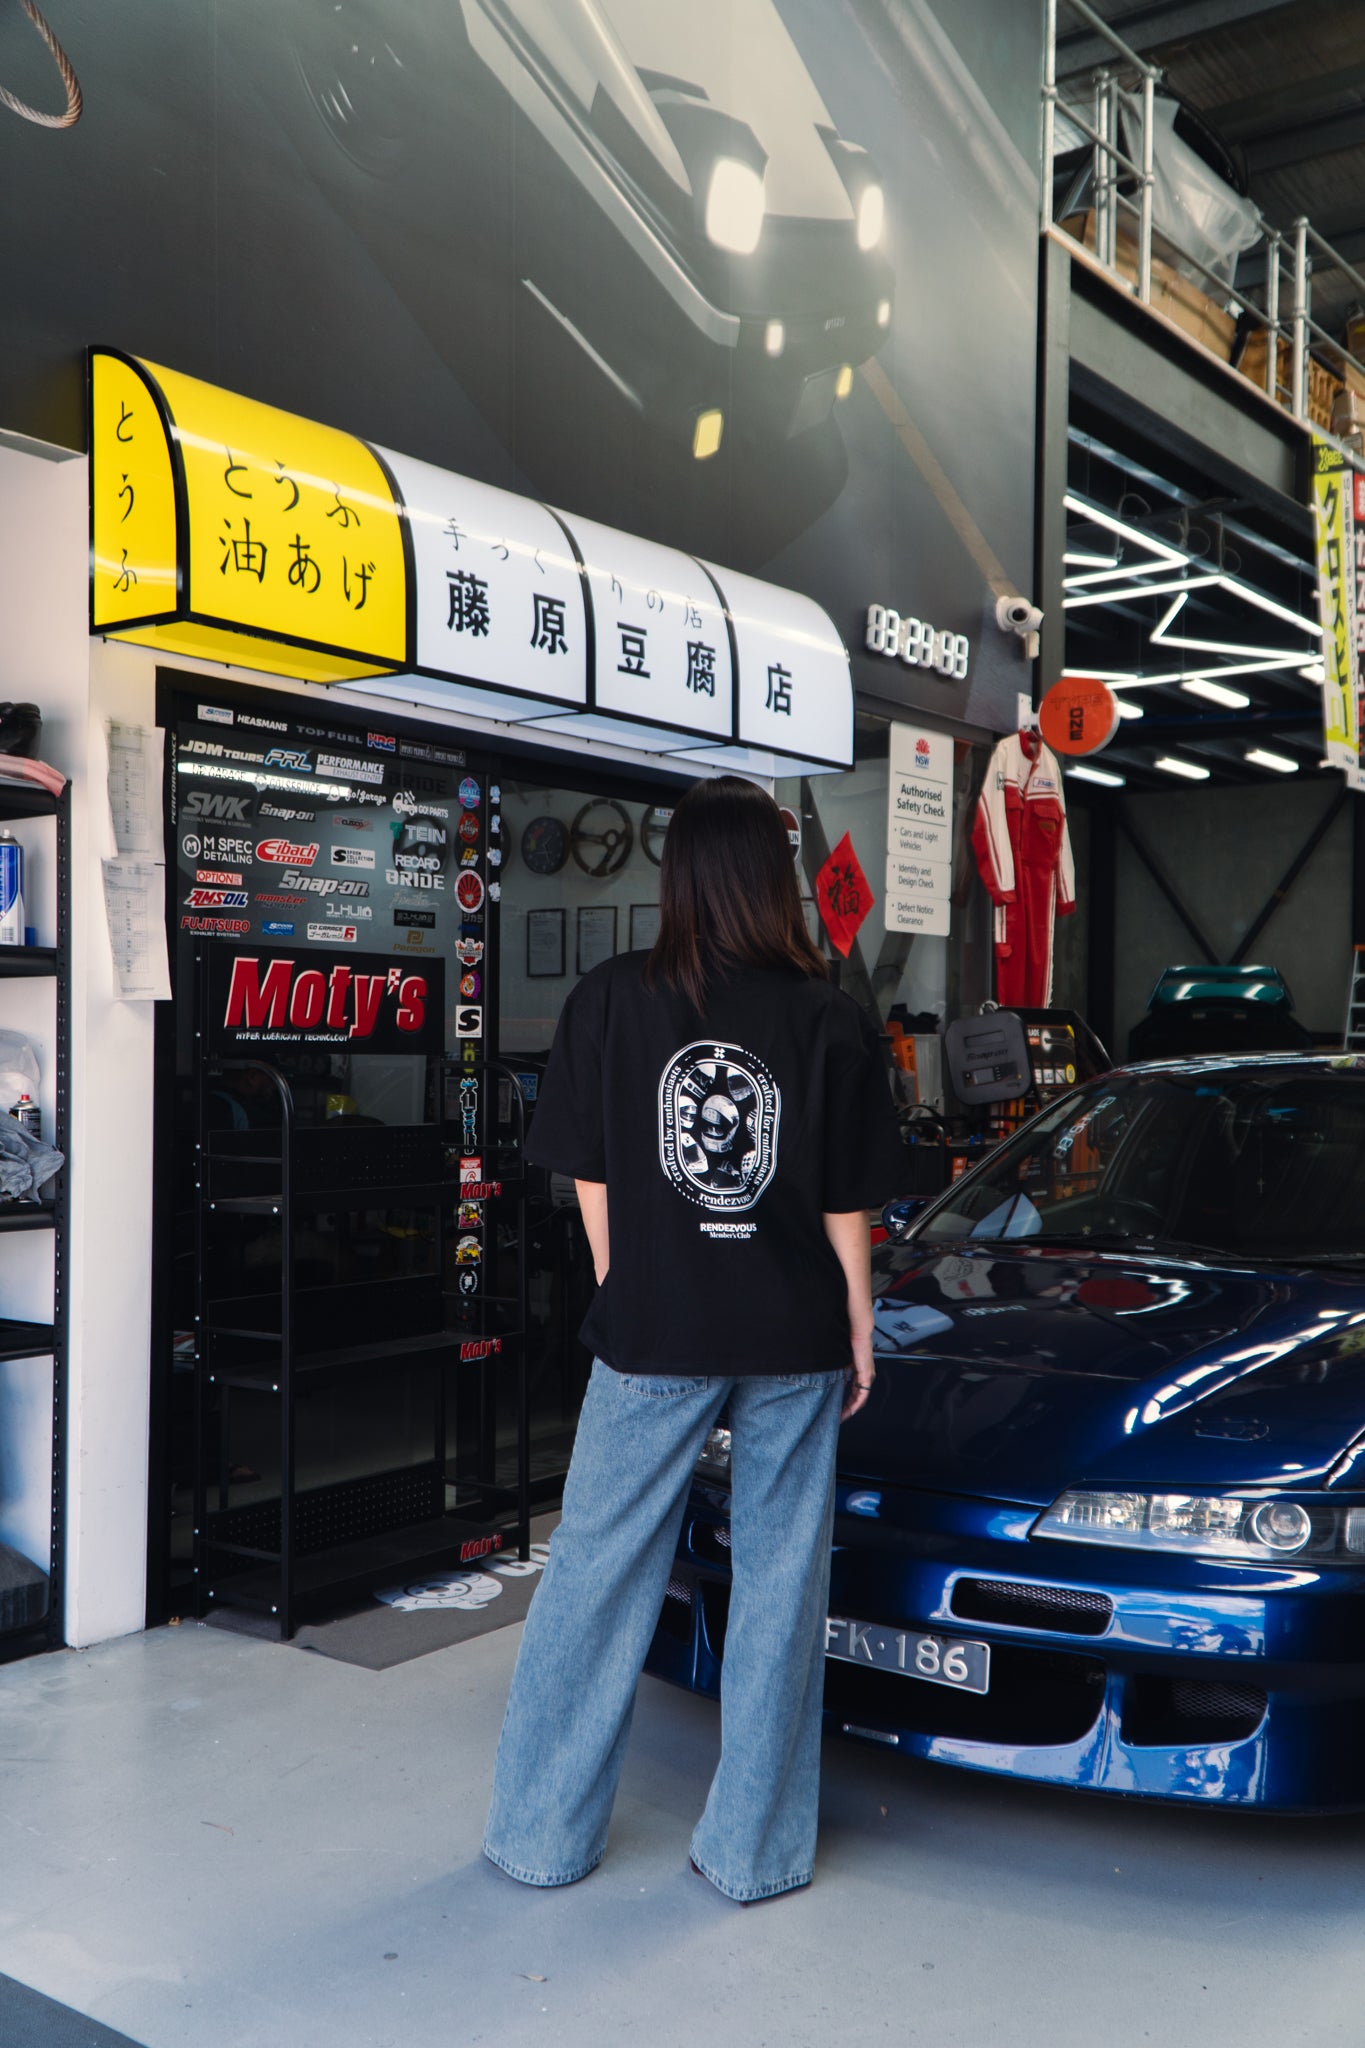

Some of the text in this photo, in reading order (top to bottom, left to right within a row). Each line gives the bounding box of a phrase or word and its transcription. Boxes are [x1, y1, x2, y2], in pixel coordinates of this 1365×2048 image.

[223, 444, 361, 528] とうふ
[113, 400, 139, 593] とうふ
[218, 516, 376, 611] 油あげ
[445, 568, 793, 716] 藤原豆腐店
[237, 714, 288, 732] HEASMANS
[1069, 706, 1083, 741] ONE
[296, 725, 363, 745] TOP FUEL
[367, 732, 396, 752] HRC
[179, 739, 224, 757] JDM
[265, 749, 312, 771] PRL
[318, 754, 385, 774] PERFORMANCE
[915, 755, 930, 766] NSW
[901, 783, 942, 803] Authorised
[182, 791, 252, 821] SWK
[259, 802, 315, 821] Snap-on
[897, 798, 945, 818] Safety Check
[404, 823, 446, 845] TEIN
[900, 827, 939, 843] Cars and Light
[203, 836, 253, 854] M SPEC
[257, 839, 319, 866] Eibach
[900, 839, 922, 852] Vehicles
[203, 850, 253, 865] DETAILING
[395, 853, 441, 872] RECARO
[197, 871, 233, 884] OPTION
[385, 869, 445, 890] BRIDE
[899, 863, 932, 877] Identity and
[279, 869, 369, 897] Snap-on
[828, 863, 859, 917] 福
[898, 875, 934, 890] Design Check
[185, 888, 248, 908] AMSOIL
[897, 902, 934, 916] Defect Notice
[181, 915, 250, 933] FUJITSUBO
[897, 913, 924, 927] Clearance
[224, 956, 428, 1039] Moty's
[236, 1032, 348, 1042] HYPER LUBRICANT TECHNOLOGY
[664, 1065, 683, 1182] crafted by enthusiasts
[753, 1073, 775, 1186] crafted for enthusiasts
[460, 1181, 502, 1200] Moty's
[698, 1192, 752, 1207] rendezvous
[700, 1223, 757, 1233] RENDEZVOUS
[460, 1338, 503, 1361] Moty's
[460, 1534, 503, 1561] Moty's
